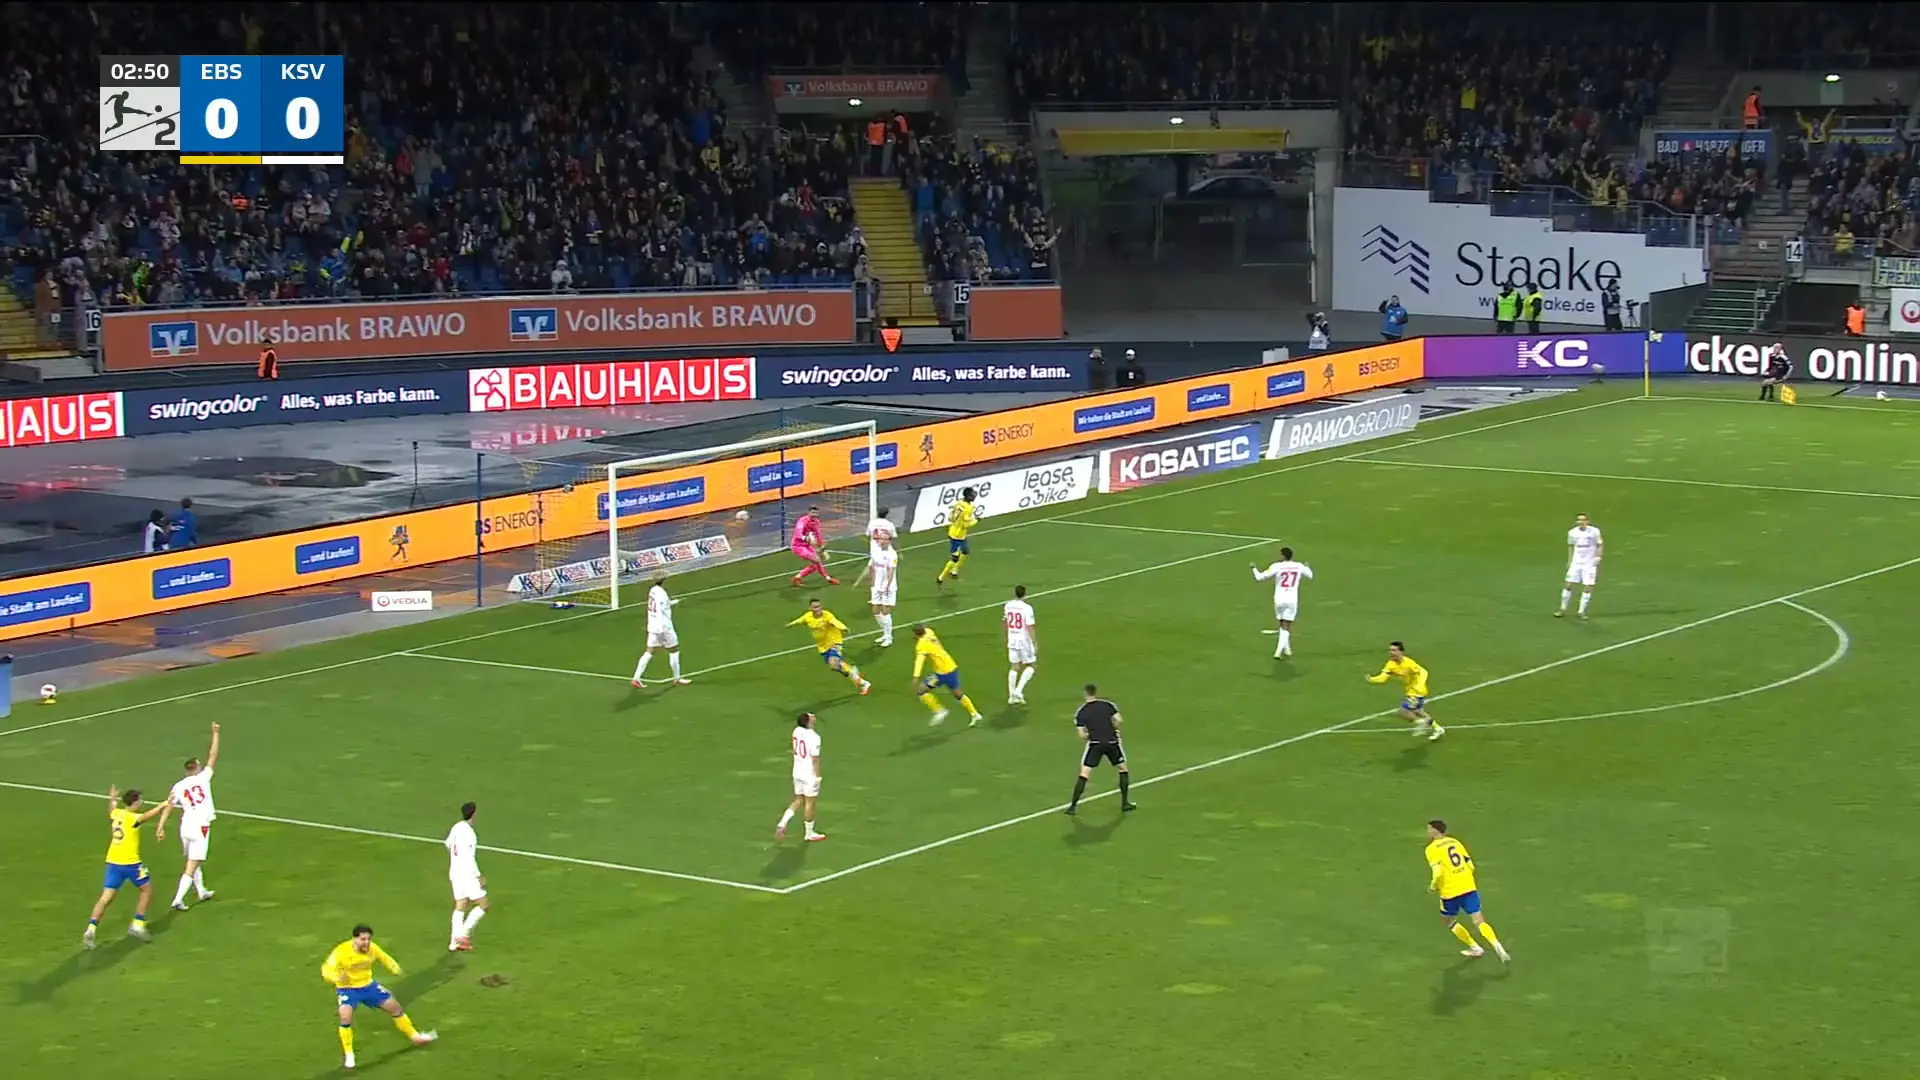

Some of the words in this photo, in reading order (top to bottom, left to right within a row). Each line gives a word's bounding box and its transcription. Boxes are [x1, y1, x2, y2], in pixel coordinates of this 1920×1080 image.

[808, 80, 874, 92] Volksbank
[878, 80, 928, 92] BRAWO
[1657, 140, 1679, 153] BAD
[1787, 242, 1803, 260] 14
[1455, 241, 1622, 292] Staake
[955, 286, 969, 301] 15
[86, 312, 101, 328] 16
[565, 306, 704, 333] Volksbank
[711, 303, 817, 328] BRAWO
[204, 316, 352, 346] Volksbank
[360, 312, 466, 340] BRAWO
[1517, 340, 1589, 369] KC
[1685, 335, 1775, 376] cker
[514, 363, 746, 403] BAUHAUS
[912, 366, 952, 383] Alles,
[954, 368, 984, 380] was
[987, 365, 1028, 380] Farbe
[1030, 364, 1071, 379] kann.
[280, 396, 320, 410] Alles,
[323, 395, 353, 407] was
[356, 388, 396, 405] Farbe
[399, 387, 440, 402] kann.
[983, 430, 996, 444] BS
[998, 423, 1034, 441] ENERGY
[1289, 404, 1412, 449] BRAWOGROUP
[1120, 436, 1250, 482] KOSATEC
[772, 470, 793, 481] Lauen
[1022, 466, 1073, 490] lease
[1019, 497, 1030, 508] a
[495, 509, 543, 532] ENERGY
[1280, 571, 1298, 587] 27
[1007, 612, 1023, 629] 28
[183, 785, 205, 807] 13
[1448, 846, 1461, 867] 6
